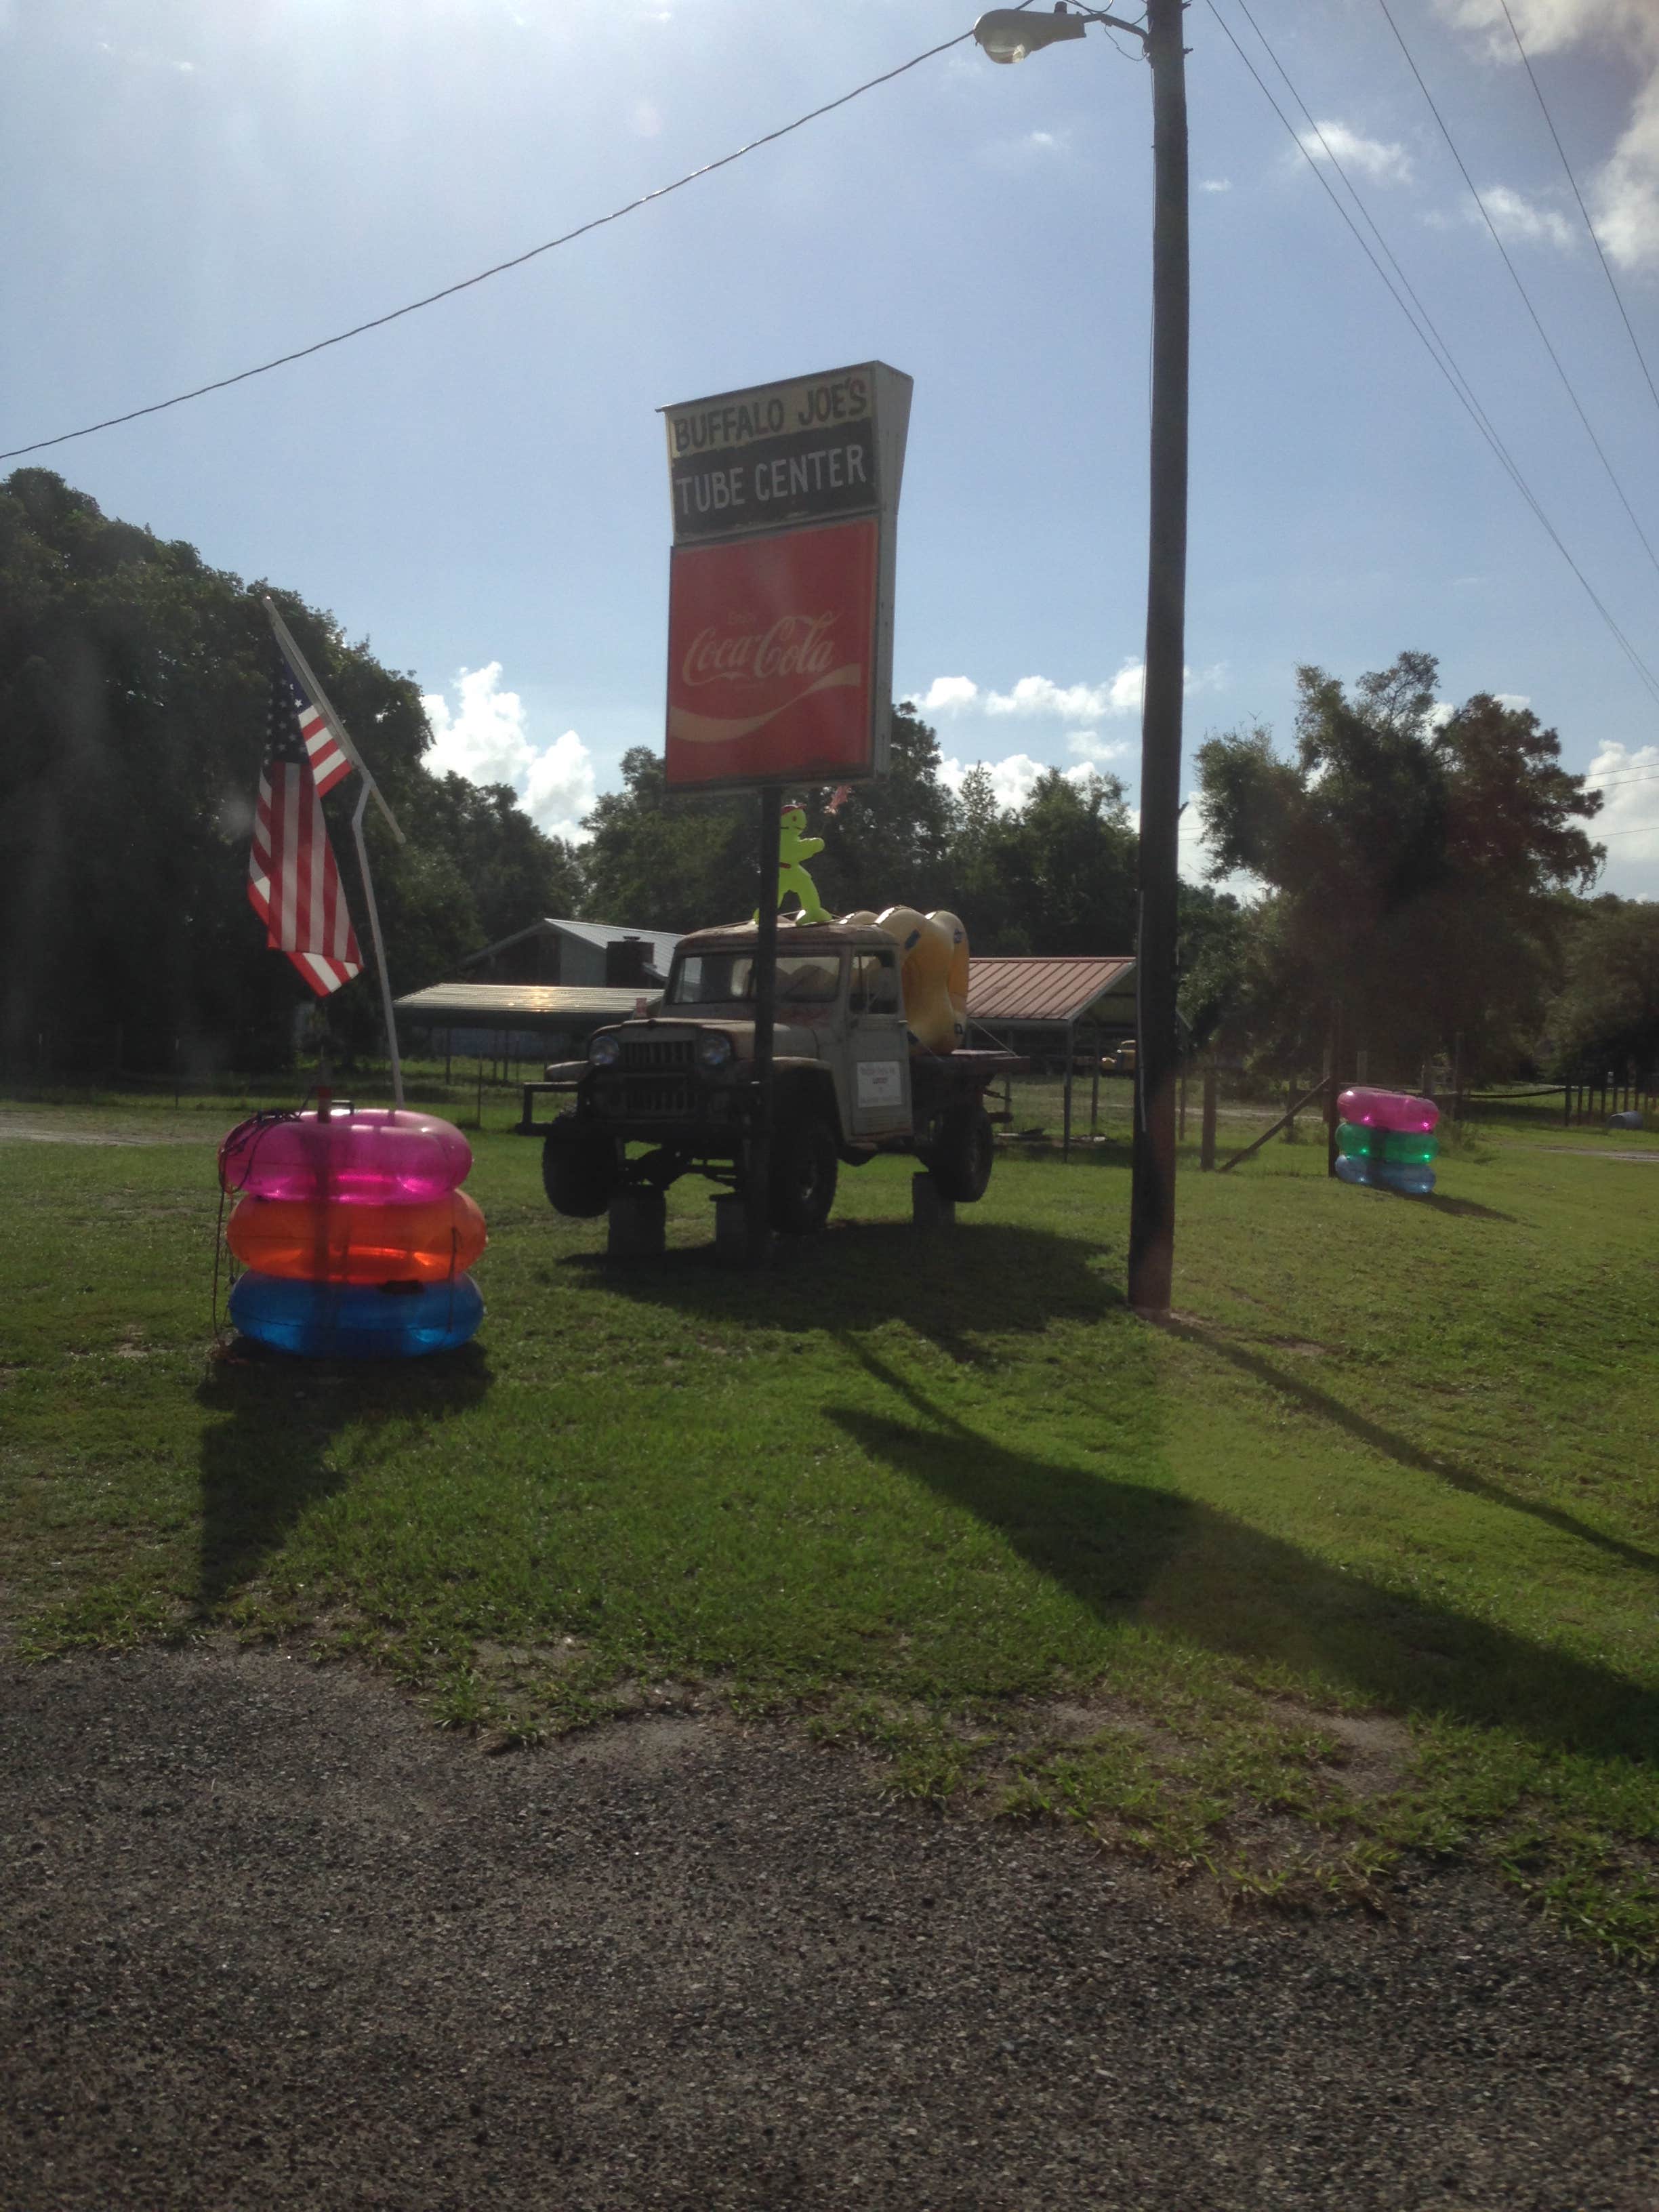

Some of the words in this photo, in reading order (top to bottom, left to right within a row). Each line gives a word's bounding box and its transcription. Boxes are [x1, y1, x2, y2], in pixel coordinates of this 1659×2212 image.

[676, 398, 784, 451] BUFFALO
[798, 377, 867, 426] JOE'S
[677, 467, 745, 514] TUBE
[754, 444, 866, 501] CENTER
